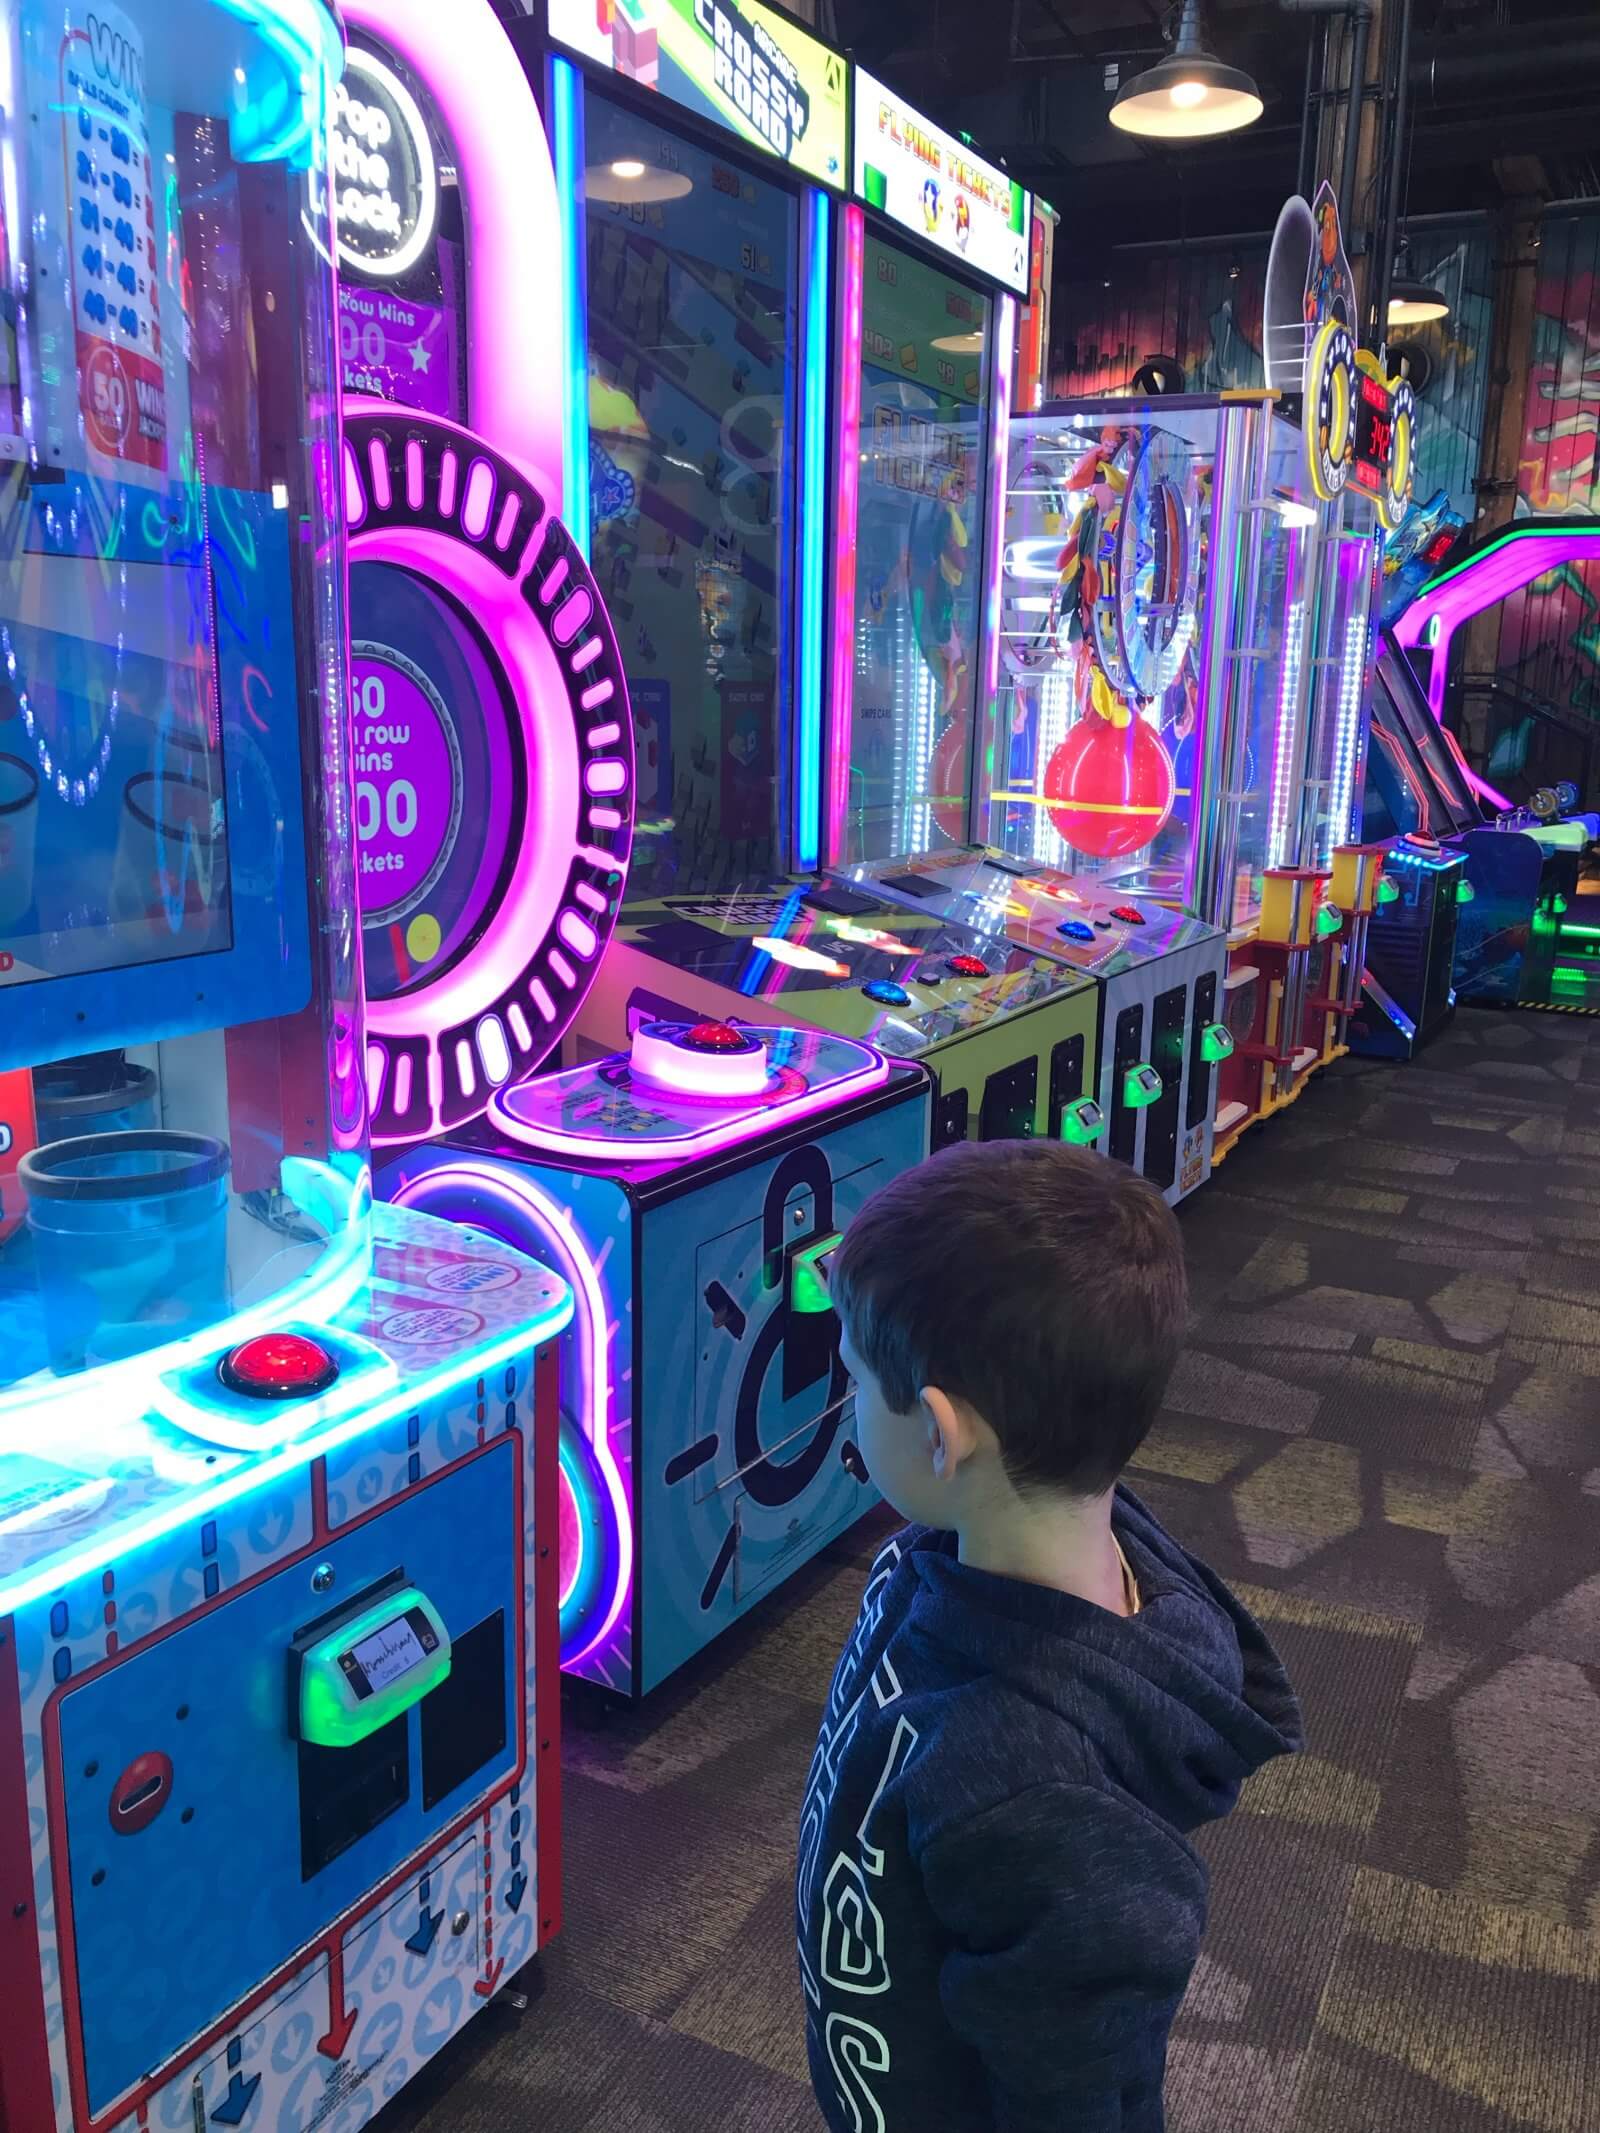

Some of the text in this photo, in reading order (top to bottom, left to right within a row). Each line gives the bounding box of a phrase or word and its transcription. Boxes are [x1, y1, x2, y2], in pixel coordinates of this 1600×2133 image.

[694, 0, 805, 138] CROSSY
[754, 22, 798, 90] ARCADE
[714, 44, 788, 159] ROAD
[878, 101, 1011, 219] FLYING TICKETS
[340, 290, 416, 328] Row Wins
[364, 724, 411, 745] row
[359, 852, 405, 875] kets
